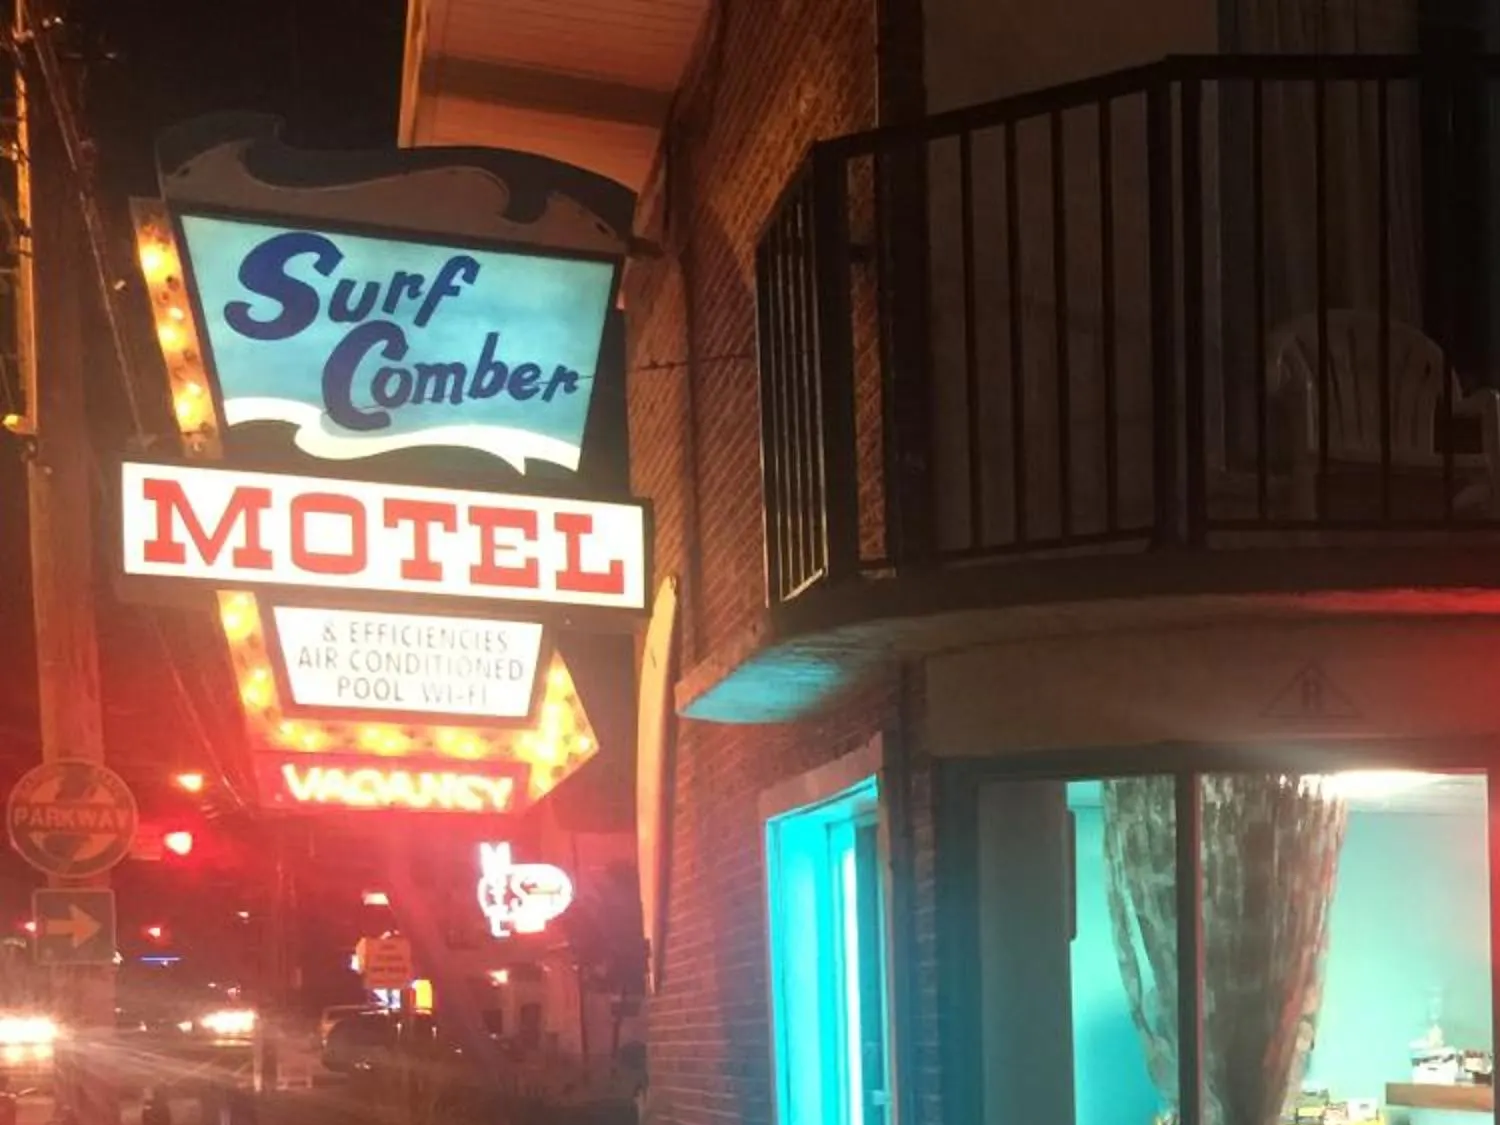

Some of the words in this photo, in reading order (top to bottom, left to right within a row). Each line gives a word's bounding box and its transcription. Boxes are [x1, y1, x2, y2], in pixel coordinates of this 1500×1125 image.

[224, 232, 482, 341] Surf
[321, 320, 582, 431] Comber
[142, 477, 626, 596] MOTEL
[349, 621, 509, 653] EFFICIENCIES
[298, 646, 338, 669] AIR
[349, 650, 525, 682] CONDITIONED
[337, 675, 405, 702] POOL
[422, 681, 488, 706] WI-FI
[281, 762, 514, 814] VACANCY
[13, 805, 131, 829] PARKWAY
